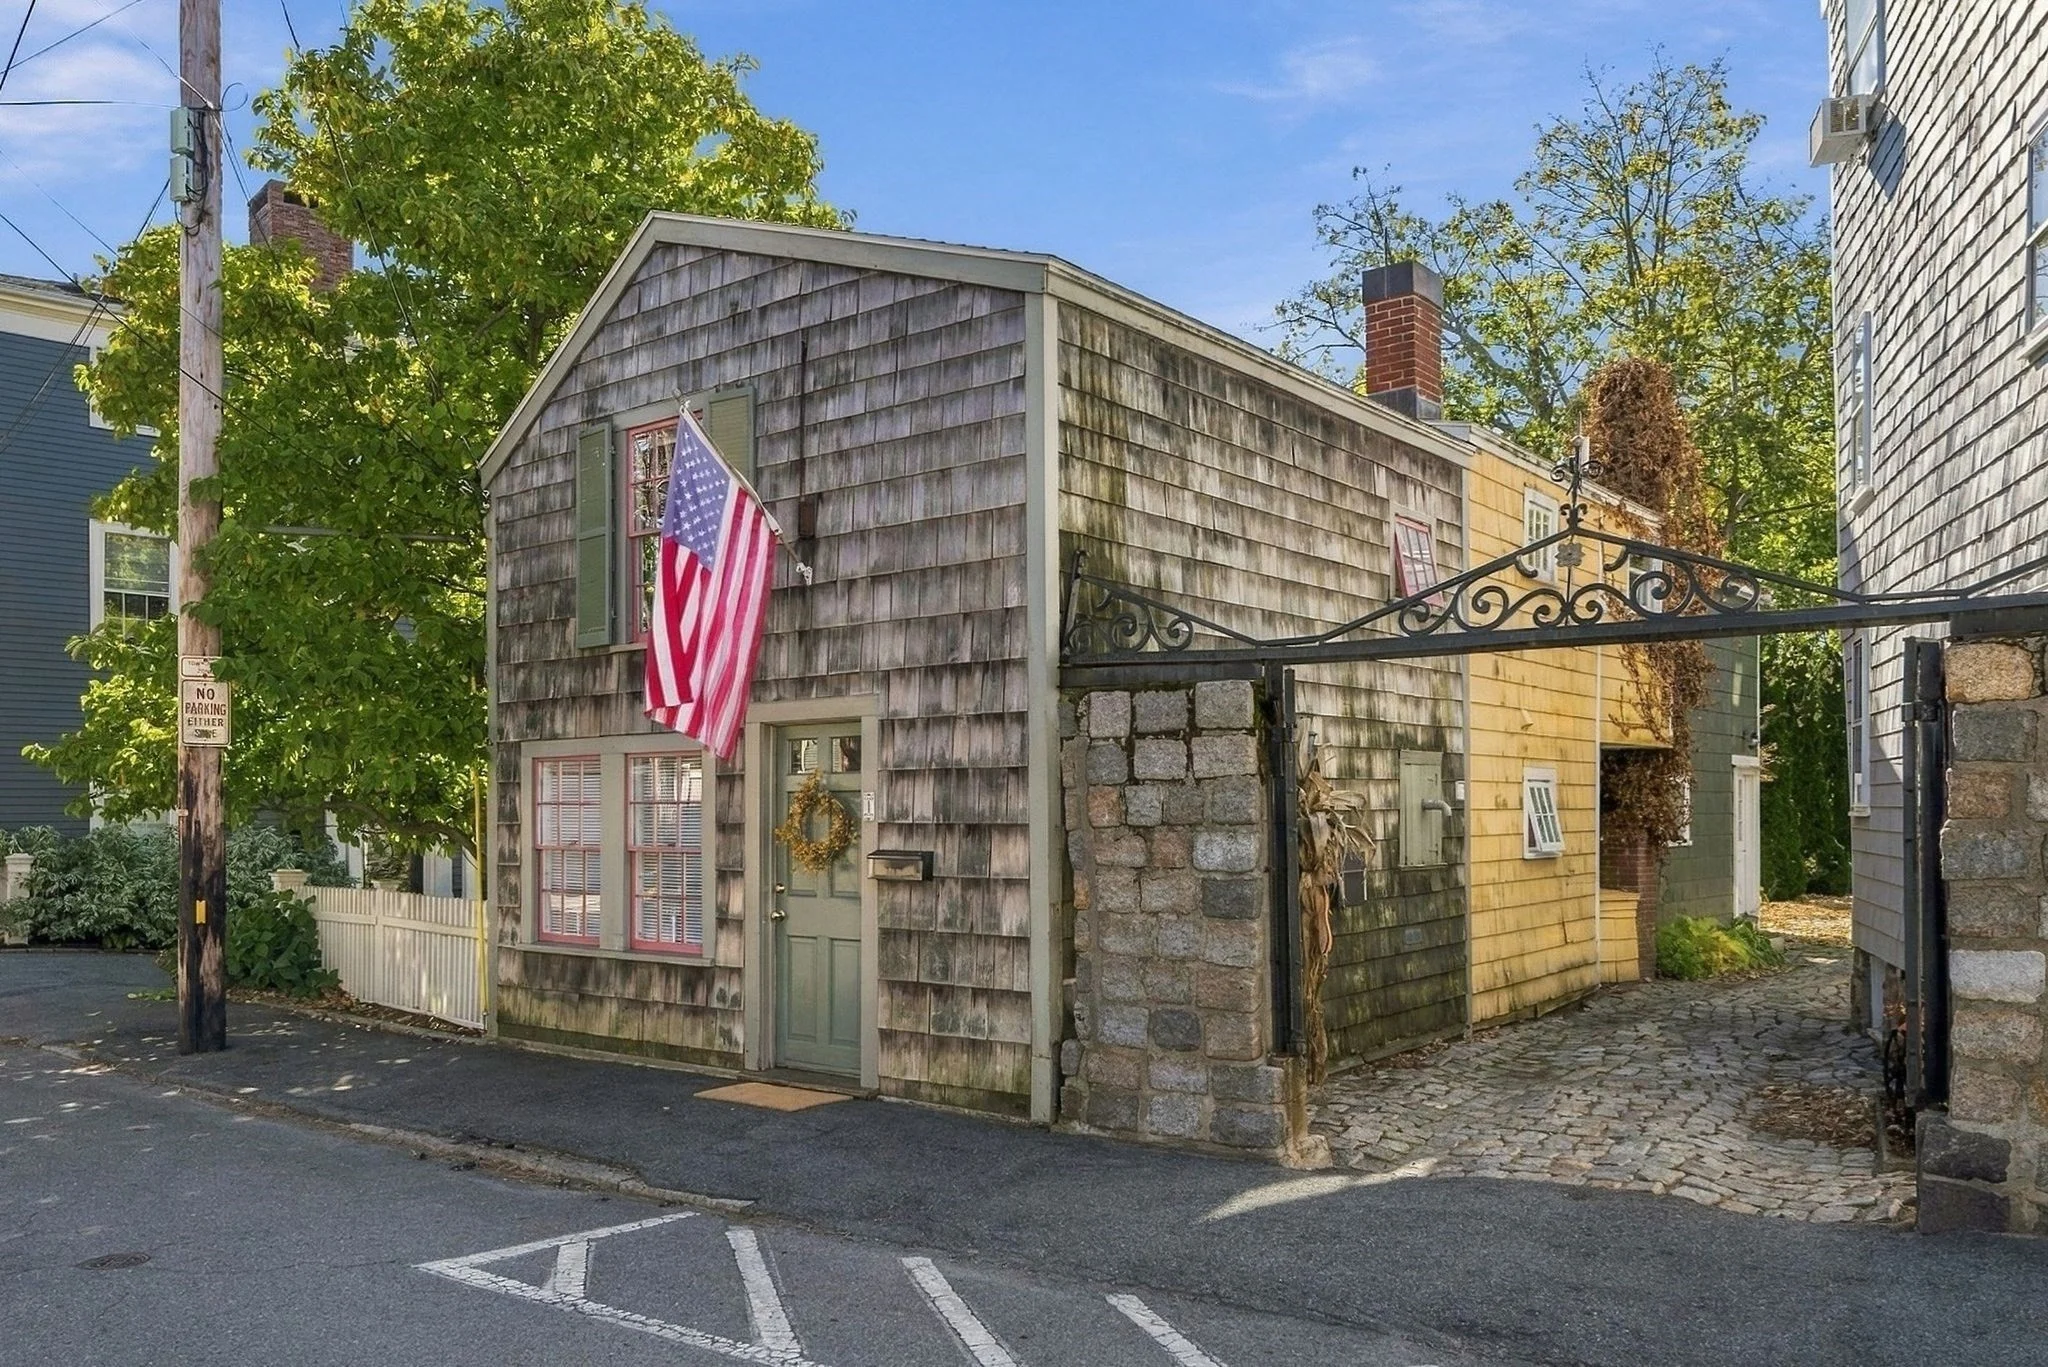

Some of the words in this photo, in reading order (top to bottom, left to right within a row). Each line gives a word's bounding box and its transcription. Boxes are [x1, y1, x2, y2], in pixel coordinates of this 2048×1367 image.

[196, 687, 215, 700] NO
[185, 702, 226, 716] PARKING
[187, 717, 224, 727] EITHER
[194, 728, 217, 739] SE
